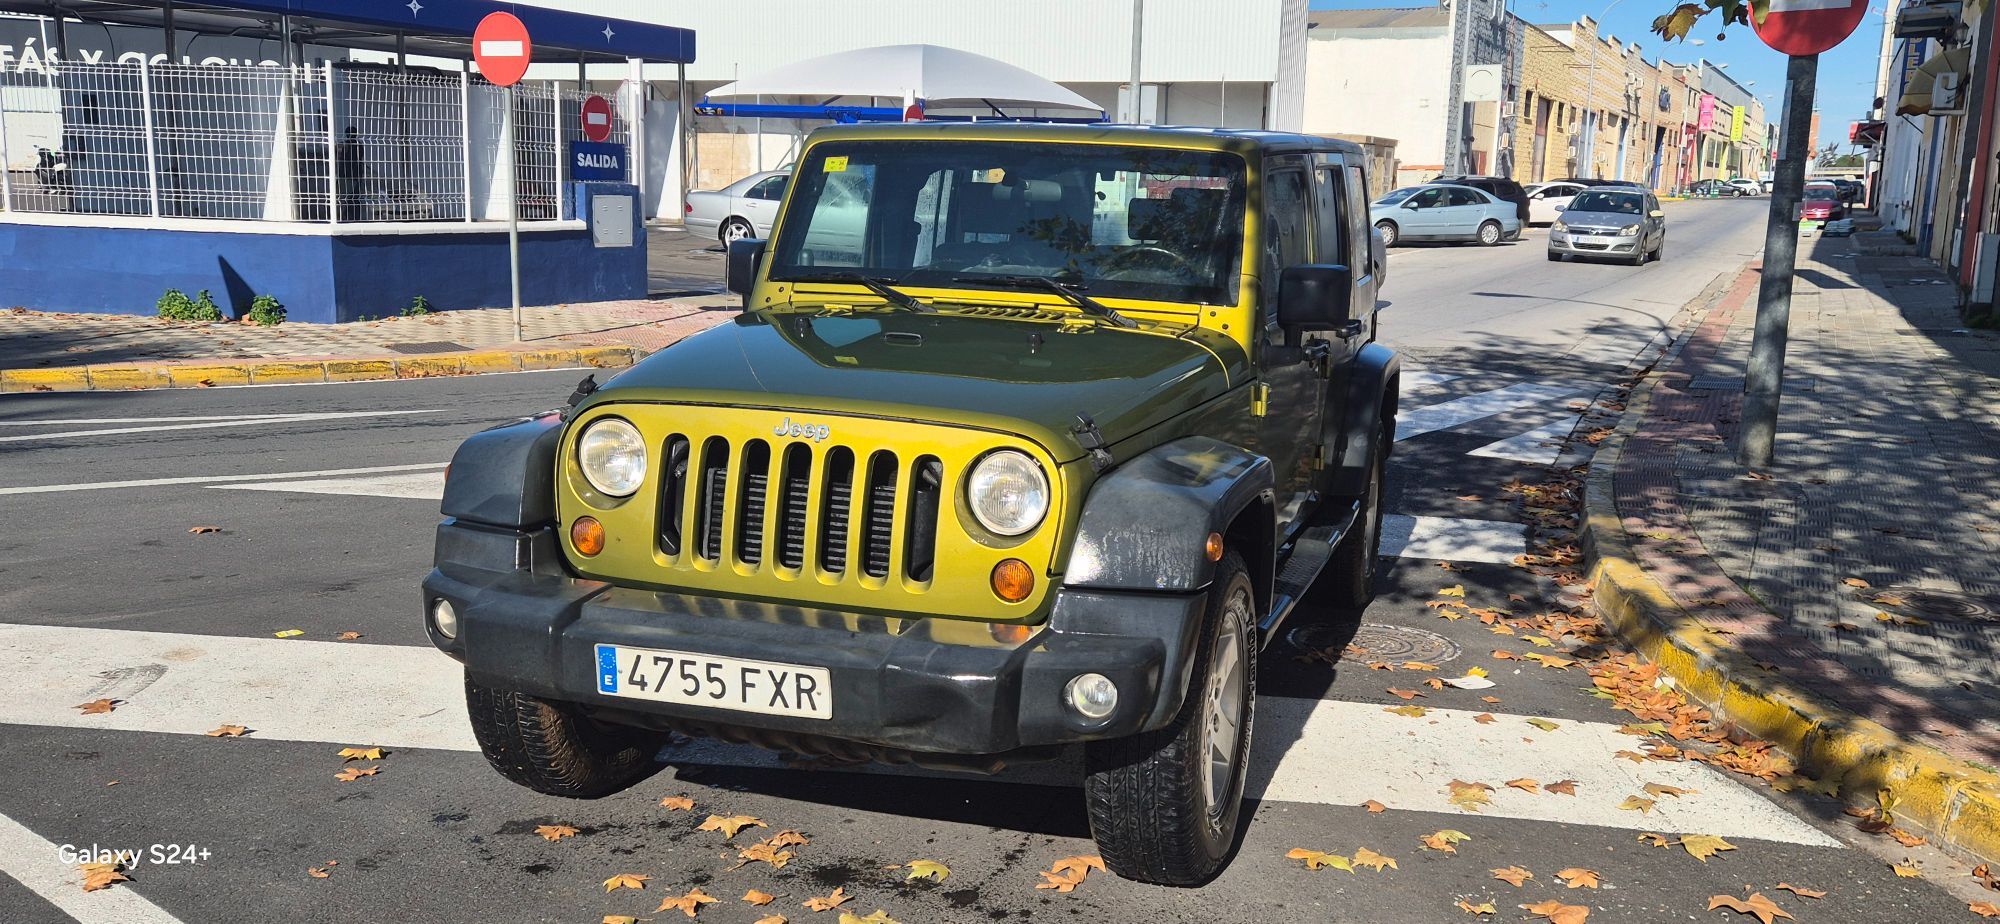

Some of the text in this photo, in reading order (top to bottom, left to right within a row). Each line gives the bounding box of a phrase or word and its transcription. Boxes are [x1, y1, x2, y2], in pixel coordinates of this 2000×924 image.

[577, 152, 619, 169] SALIDA
[774, 416, 830, 443] Jeep
[604, 674, 614, 686] E
[627, 654, 818, 712] 4755 FXR
